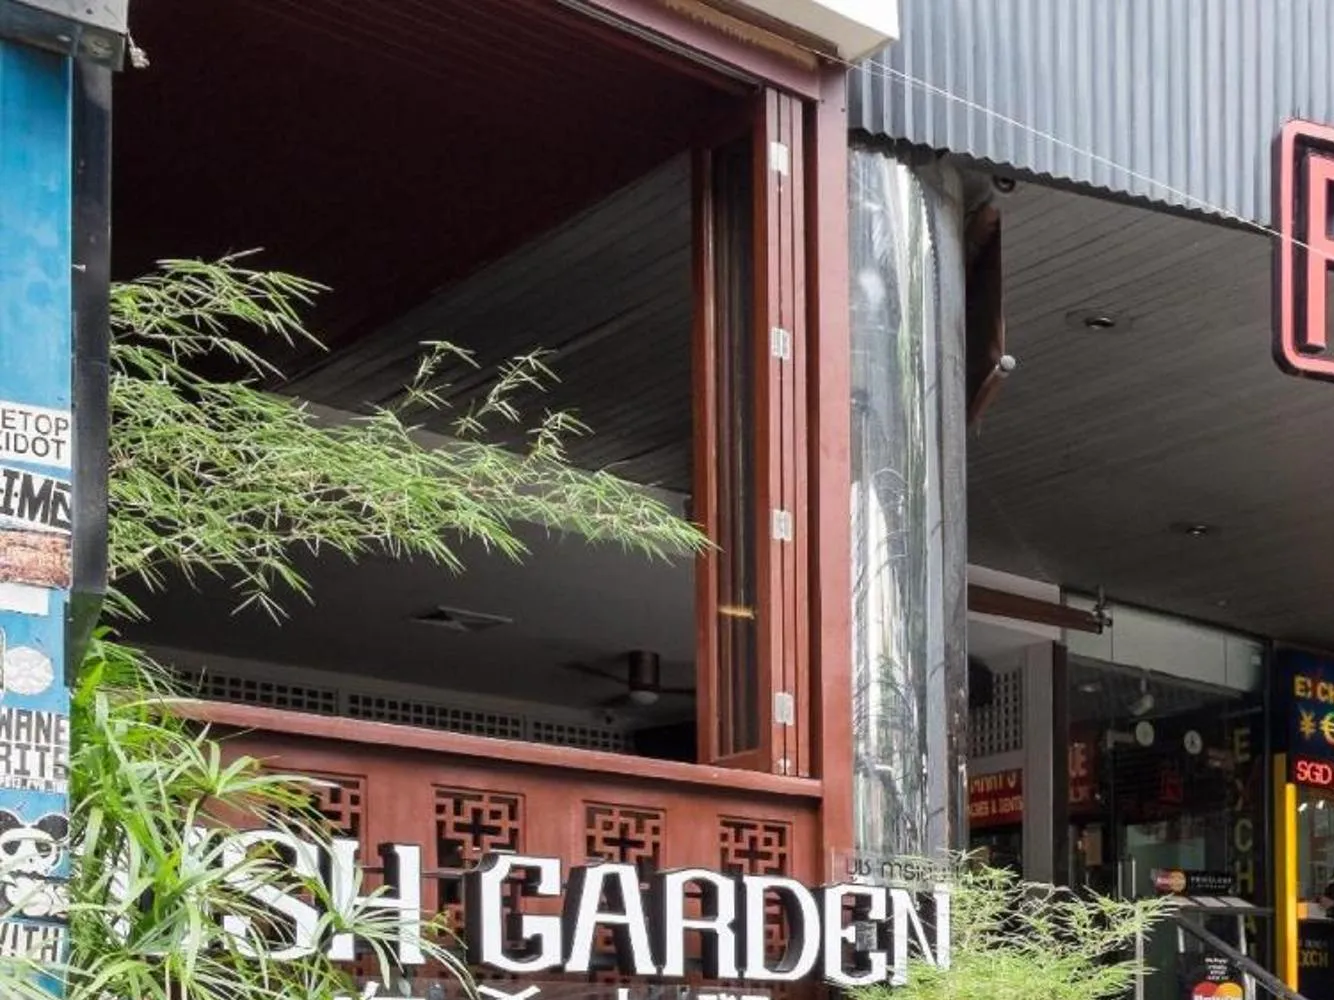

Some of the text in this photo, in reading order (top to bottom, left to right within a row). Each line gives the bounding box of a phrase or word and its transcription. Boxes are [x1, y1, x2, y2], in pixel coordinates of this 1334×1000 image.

[1, 407, 69, 436] ETOP
[1296, 760, 1333, 785] SGD
[480, 852, 951, 988] GARDEN
